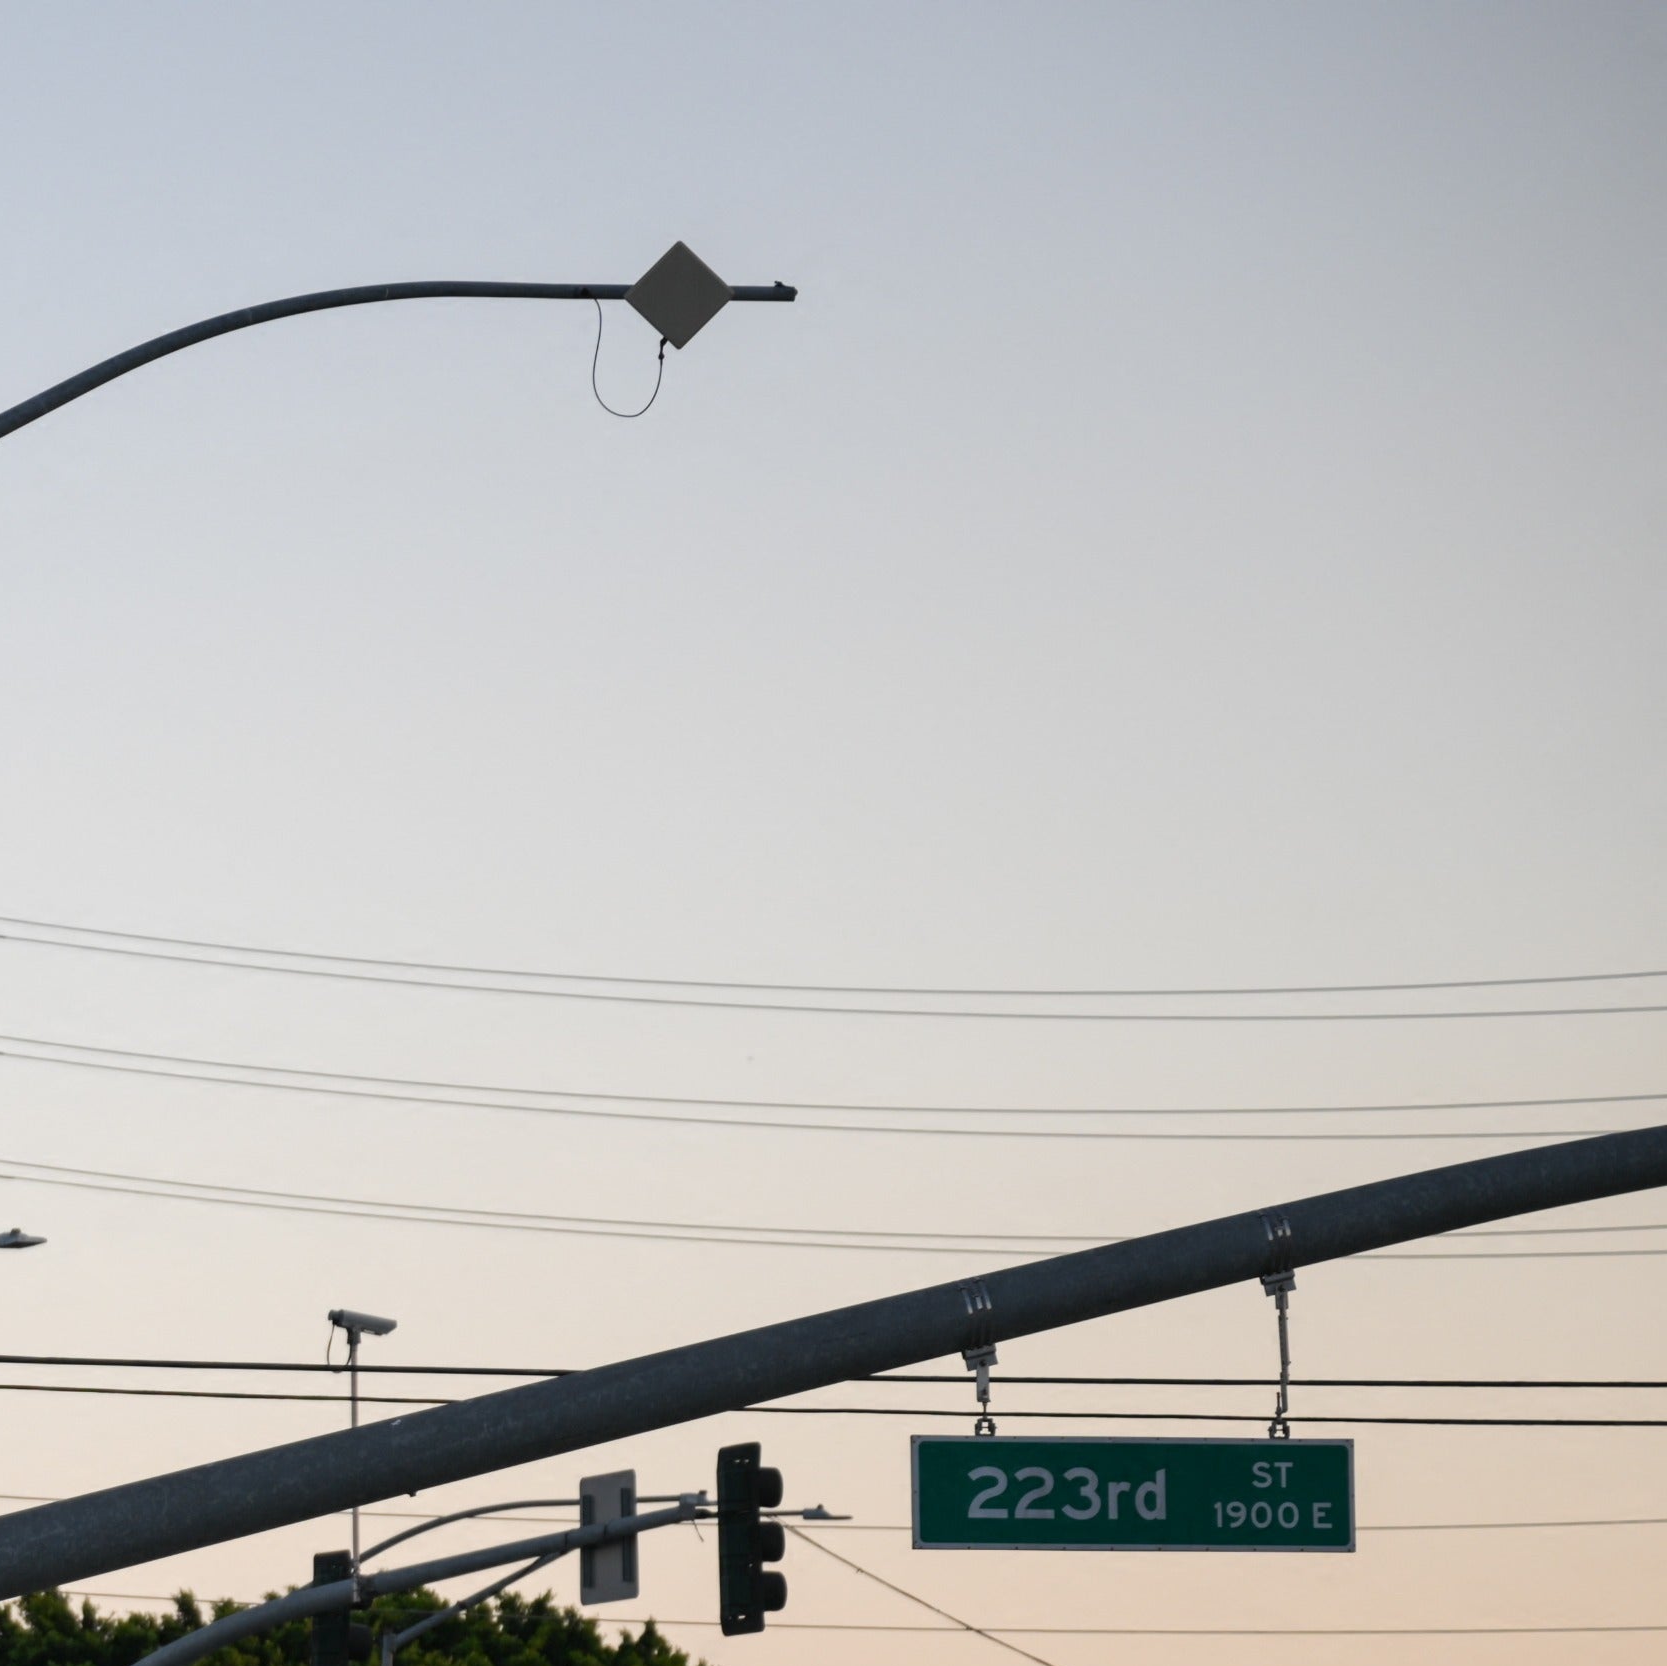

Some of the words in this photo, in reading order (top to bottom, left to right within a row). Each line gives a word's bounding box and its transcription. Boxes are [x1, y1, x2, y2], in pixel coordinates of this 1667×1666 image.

[967, 1466, 1167, 1521] 223rd
[1252, 1462, 1294, 1489] ST
[1213, 1501, 1300, 1529] 1900
[1313, 1502, 1333, 1529] E
